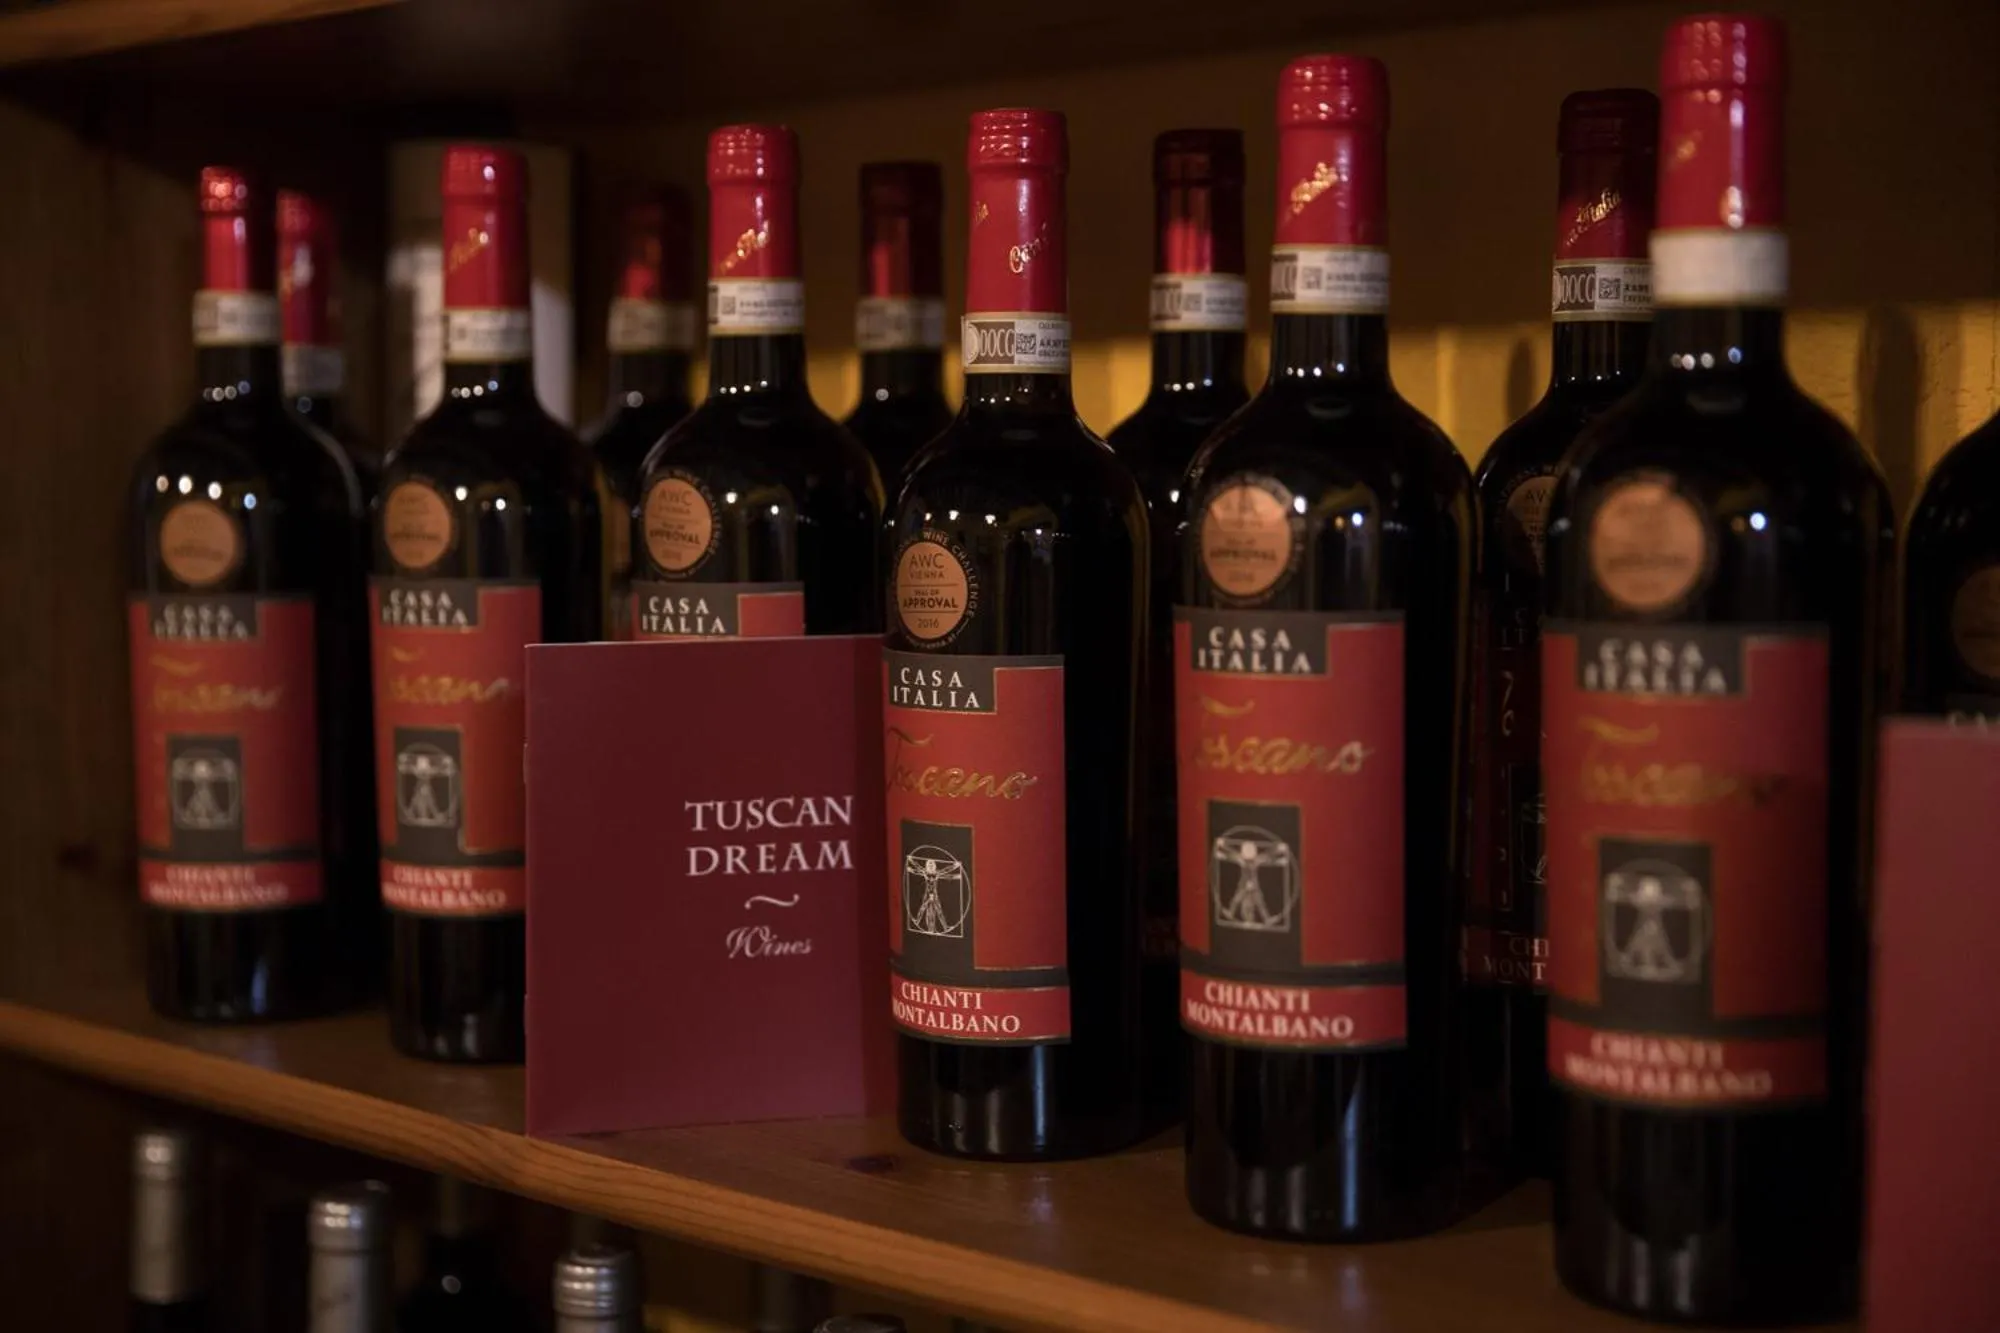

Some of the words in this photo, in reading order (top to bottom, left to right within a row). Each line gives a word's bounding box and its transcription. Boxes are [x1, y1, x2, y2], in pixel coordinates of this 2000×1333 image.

[909, 553, 944, 569] AWC
[951, 544, 979, 618] CHALLENGE
[390, 588, 452, 609] CASA
[649, 596, 709, 615] CASA
[903, 597, 959, 609] APPROVAL
[642, 614, 725, 634] ITALIA
[917, 618, 940, 629] 2016
[1208, 626, 1292, 651] CASA
[1198, 648, 1311, 673] ITALIA
[900, 667, 963, 688] CASA
[893, 685, 980, 708] ITALIA
[684, 795, 854, 832] TUSCAN
[685, 840, 855, 877] DREAM
[726, 925, 812, 959] Wines
[901, 981, 983, 1010] CHIANTI
[1205, 978, 1309, 1012] CHIANTI
[1186, 999, 1354, 1039] MONTALBANO
